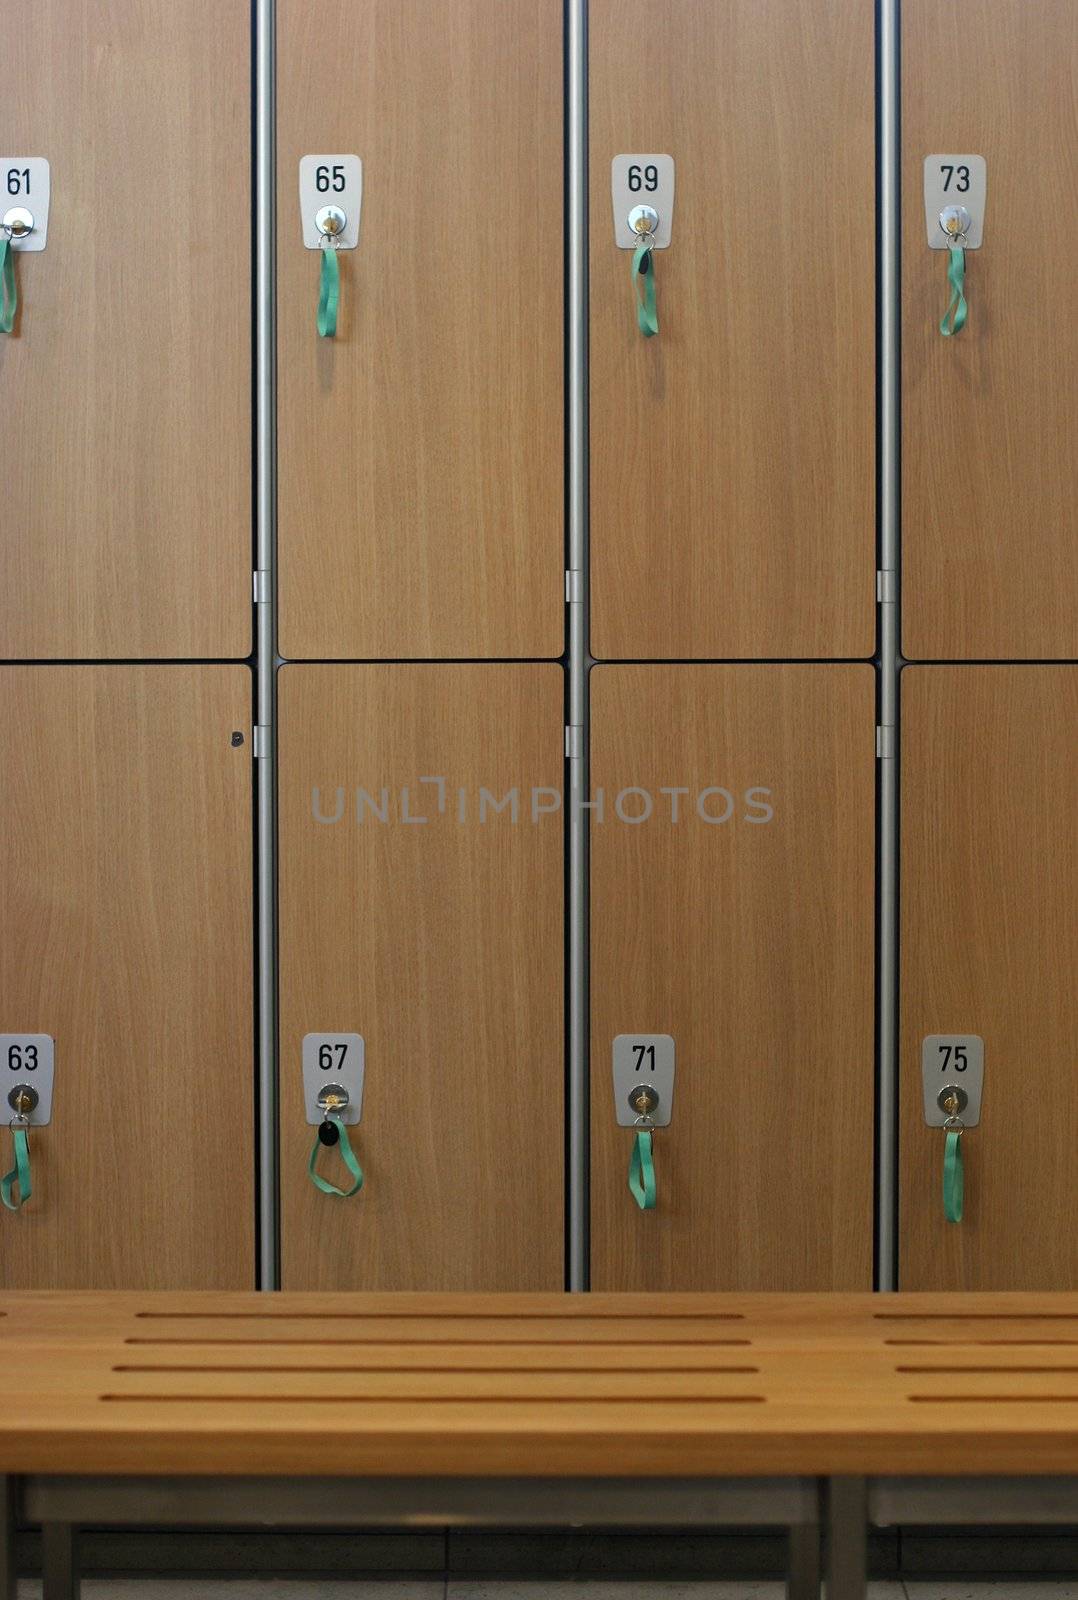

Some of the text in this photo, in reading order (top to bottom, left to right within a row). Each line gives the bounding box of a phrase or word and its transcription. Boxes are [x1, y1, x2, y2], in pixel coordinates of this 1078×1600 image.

[7, 168, 30, 196] 61
[316, 165, 346, 193] 65
[628, 165, 658, 193] 69
[940, 165, 970, 193] 73
[7, 1044, 39, 1072] 63
[318, 1043, 349, 1071] 67
[631, 1043, 656, 1072] 71
[939, 1044, 967, 1073] 75
